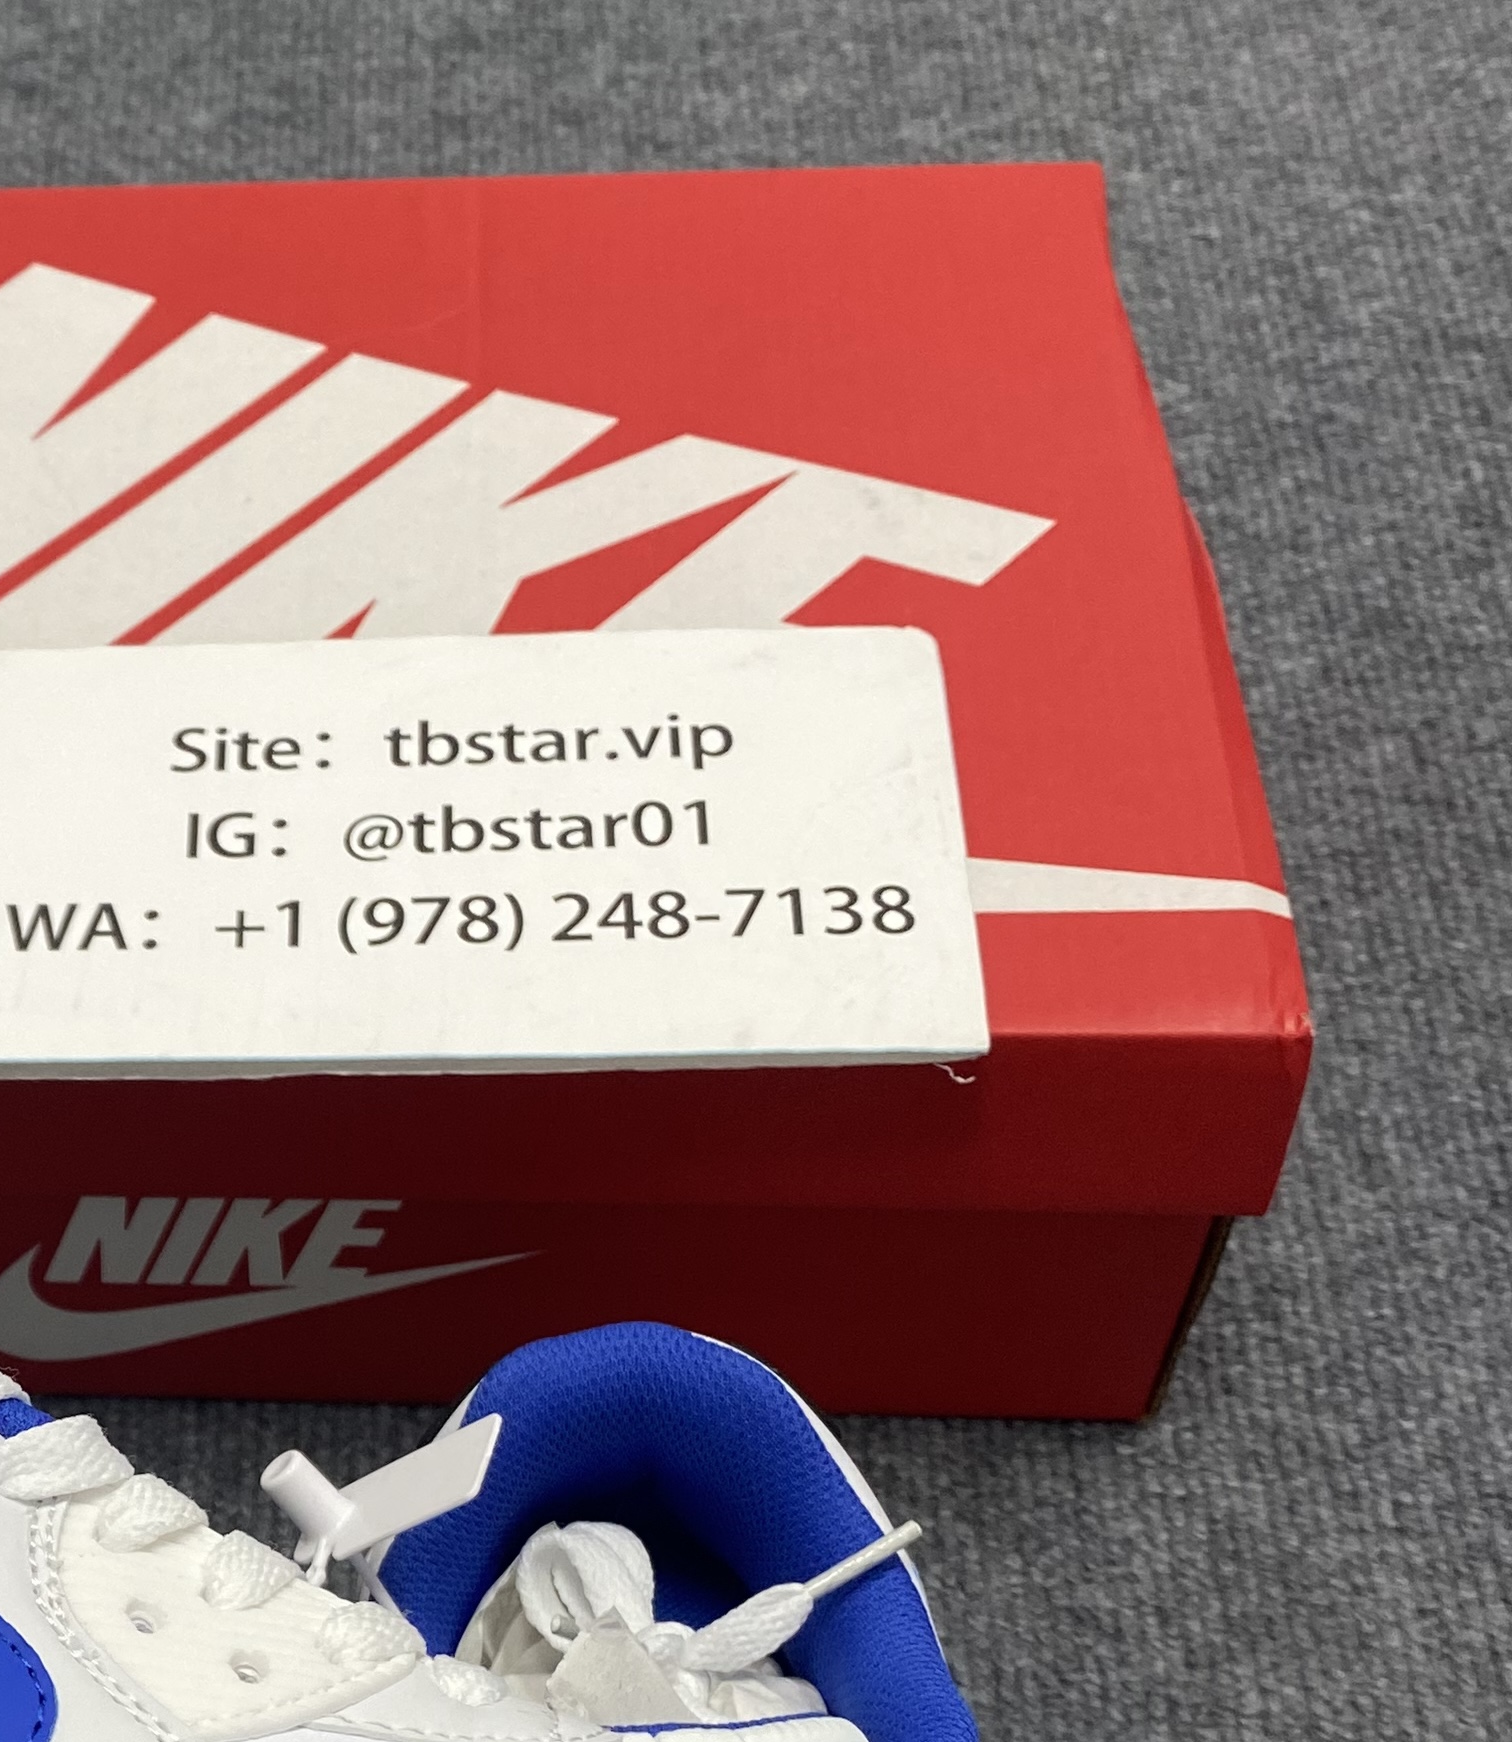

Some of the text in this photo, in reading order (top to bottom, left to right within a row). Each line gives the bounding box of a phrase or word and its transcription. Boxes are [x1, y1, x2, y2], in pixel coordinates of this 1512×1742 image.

[171, 714, 733, 773] Site: tbstar.vip
[187, 800, 711, 862] IG: @tbstar01
[7, 885, 915, 954] WA: +1 (978) 248-7138
[44, 1196, 402, 1287] NIKE
